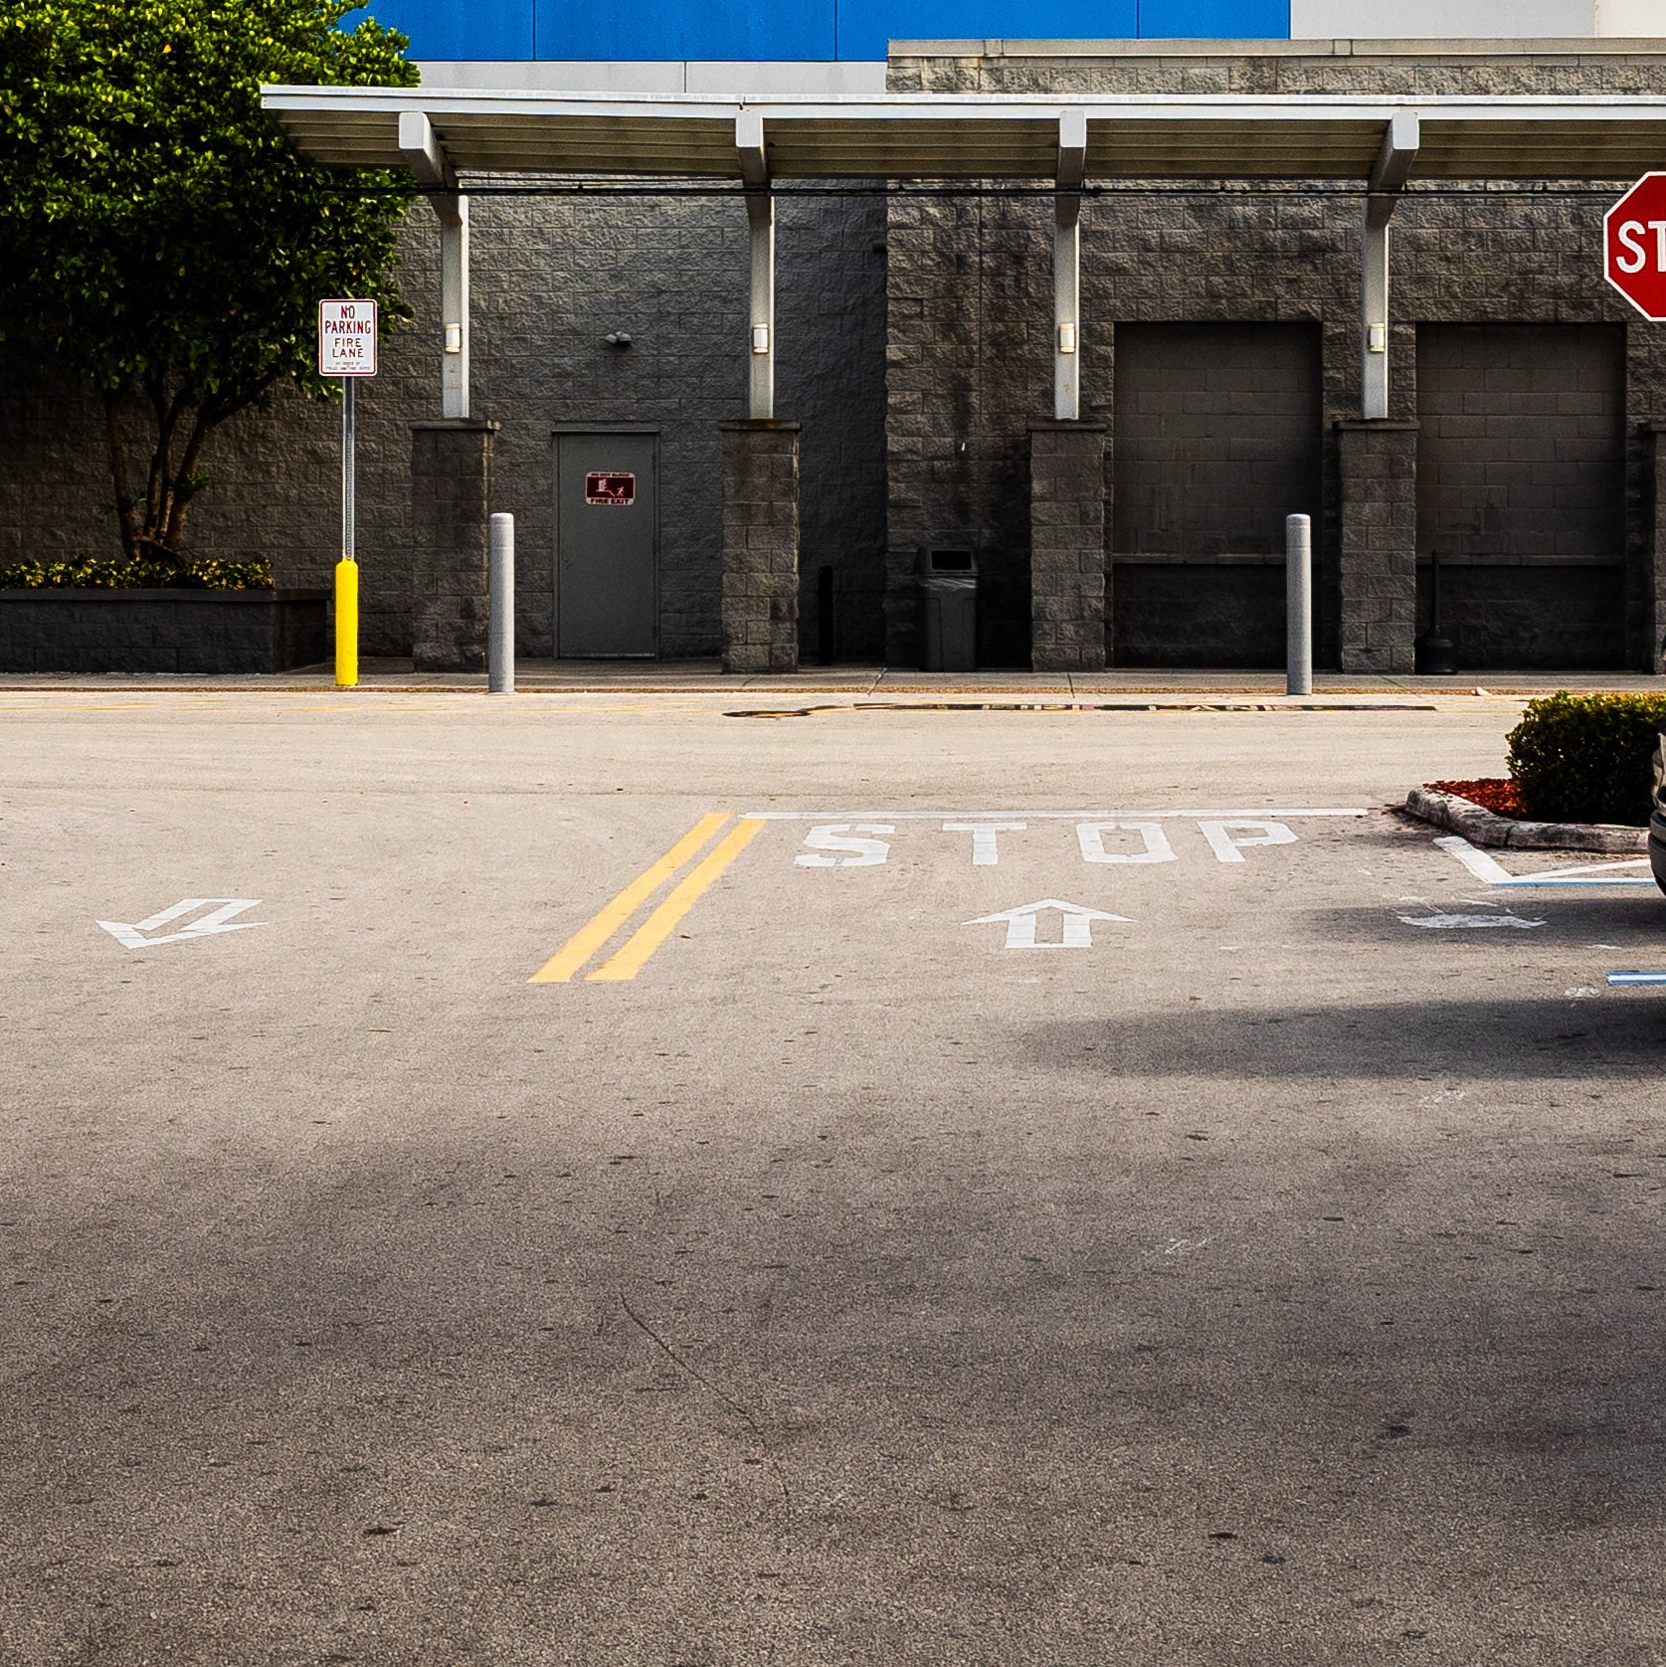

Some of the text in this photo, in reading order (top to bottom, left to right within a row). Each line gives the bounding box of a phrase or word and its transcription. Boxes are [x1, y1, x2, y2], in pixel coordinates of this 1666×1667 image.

[341, 305, 356, 319] NO
[325, 320, 371, 334] PARKING
[334, 337, 362, 348] FIRE
[332, 348, 364, 358] LANE
[793, 819, 1300, 868] STOP
